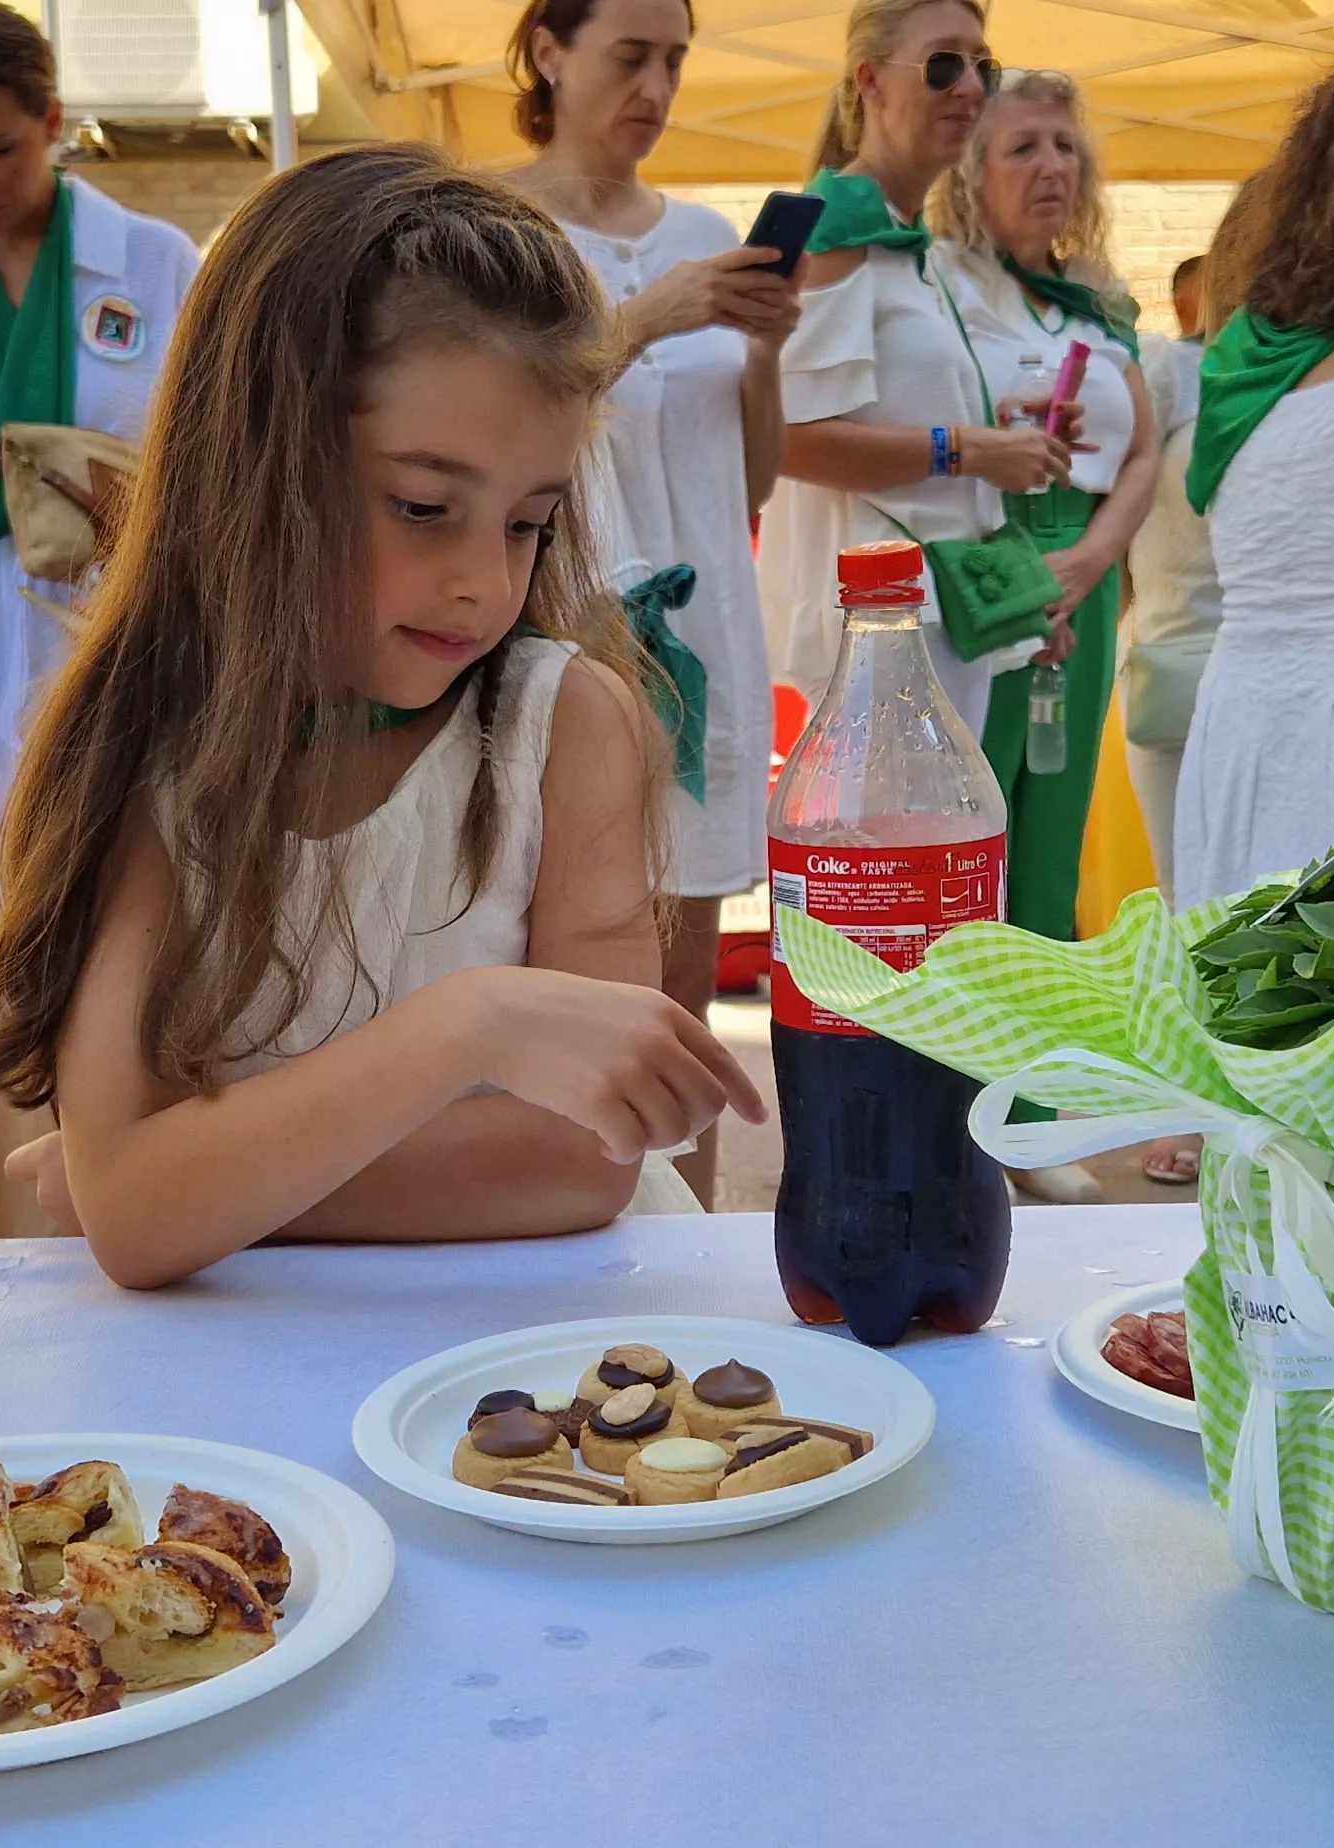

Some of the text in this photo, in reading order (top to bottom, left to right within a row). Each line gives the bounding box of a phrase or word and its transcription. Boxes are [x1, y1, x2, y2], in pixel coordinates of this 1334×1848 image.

[806, 854, 850, 875] Coke
[861, 860, 911, 868] ORIGINAL
[945, 851, 952, 873] 1
[957, 859, 975, 872] Litro
